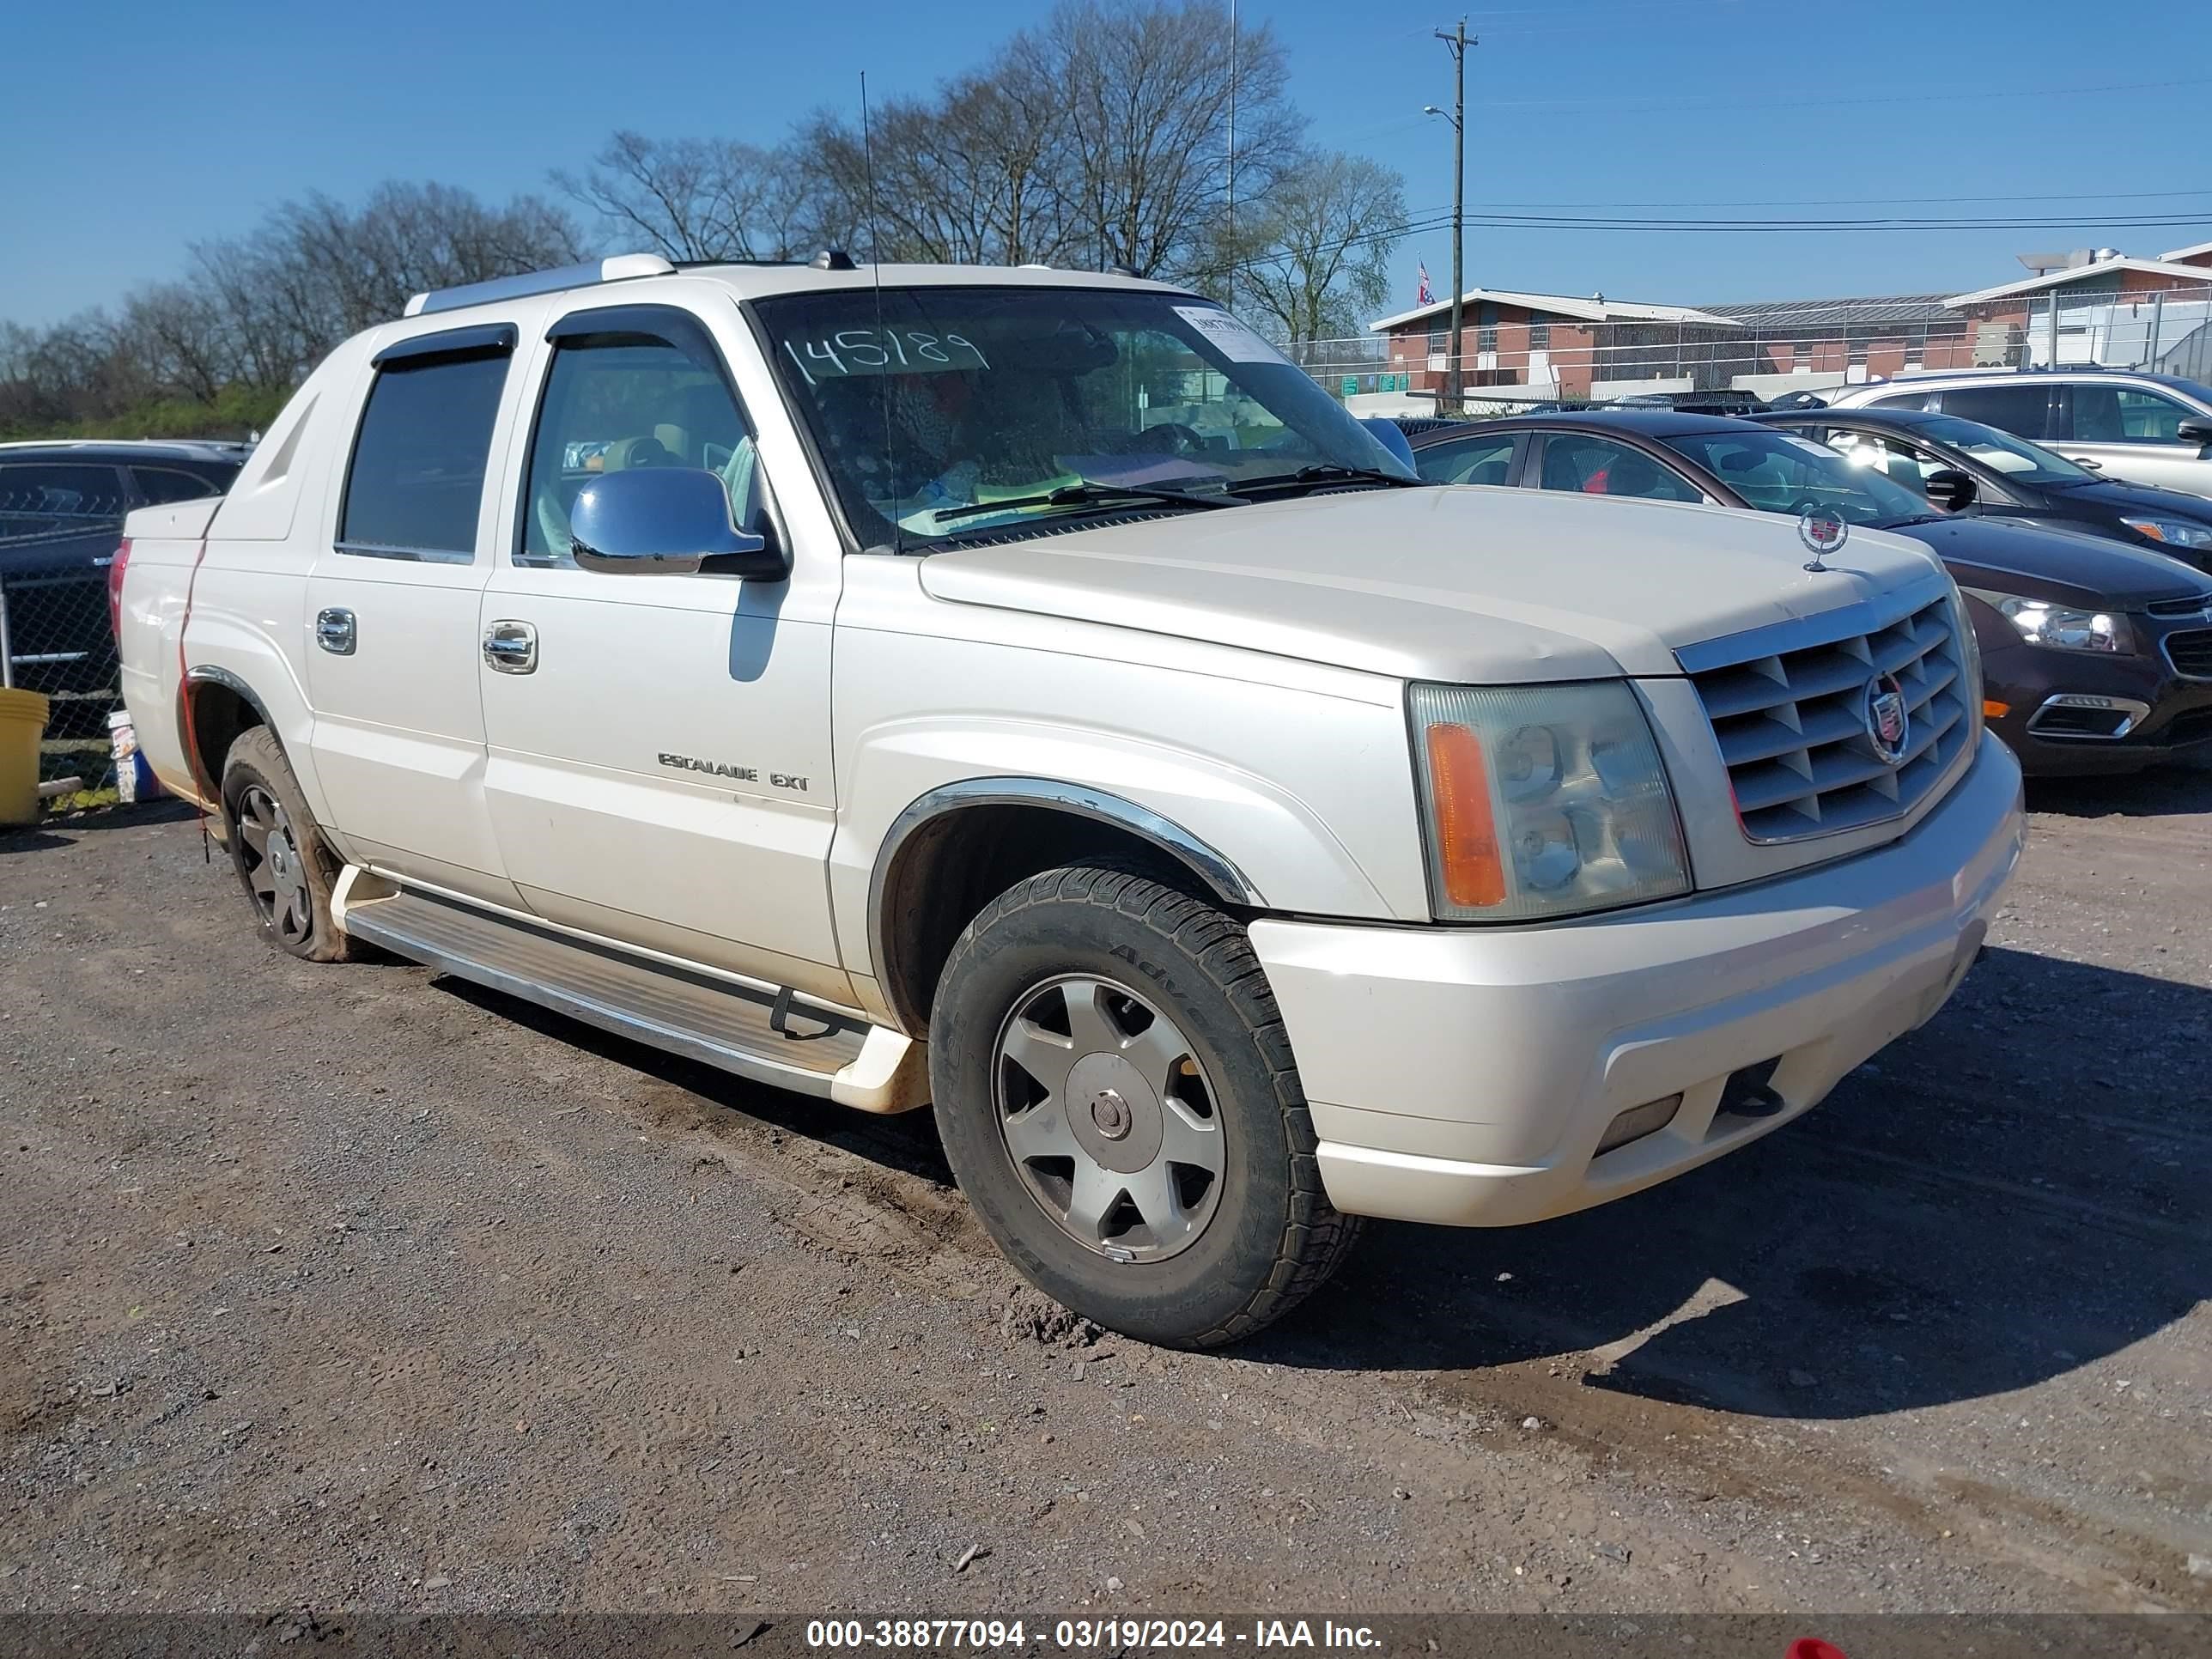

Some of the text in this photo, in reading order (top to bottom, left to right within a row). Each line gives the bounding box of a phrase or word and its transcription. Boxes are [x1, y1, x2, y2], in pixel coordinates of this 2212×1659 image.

[783, 329, 991, 386] 145189
[658, 752, 810, 792] ESCALADE EXT
